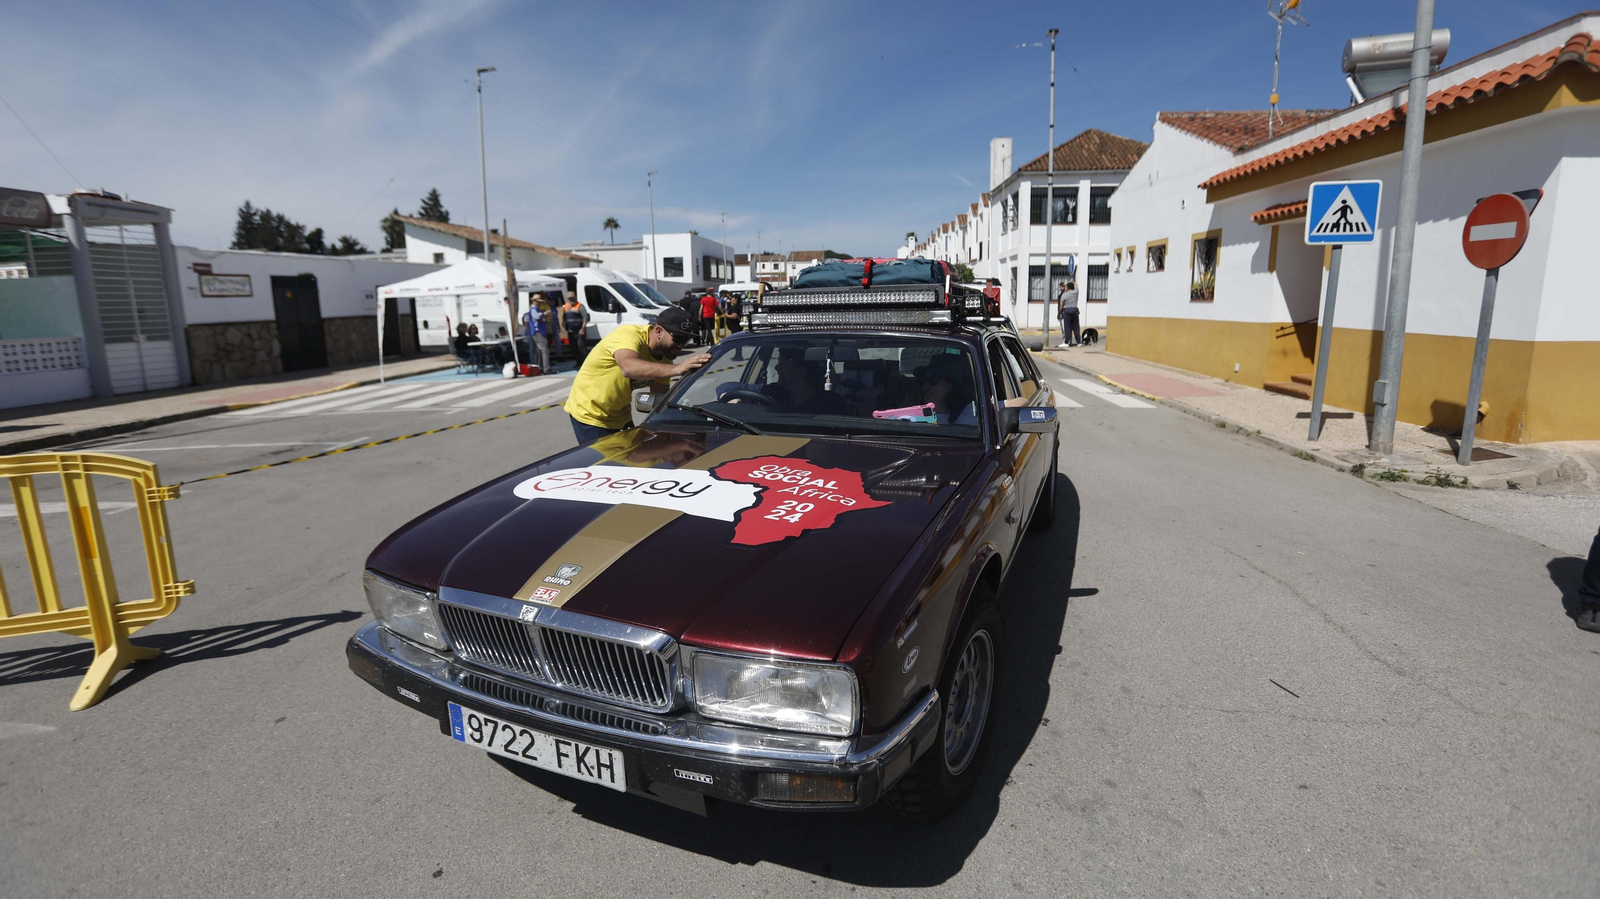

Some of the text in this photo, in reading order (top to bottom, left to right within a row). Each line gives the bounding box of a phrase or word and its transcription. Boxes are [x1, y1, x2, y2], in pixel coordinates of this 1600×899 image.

[760, 464, 812, 476] Obra
[748, 470, 838, 489] SOCIAL
[776, 500, 815, 512] 20
[763, 509, 803, 523] 24
[543, 575, 571, 587] RHINO
[454, 713, 615, 784] E 9722 FKH
